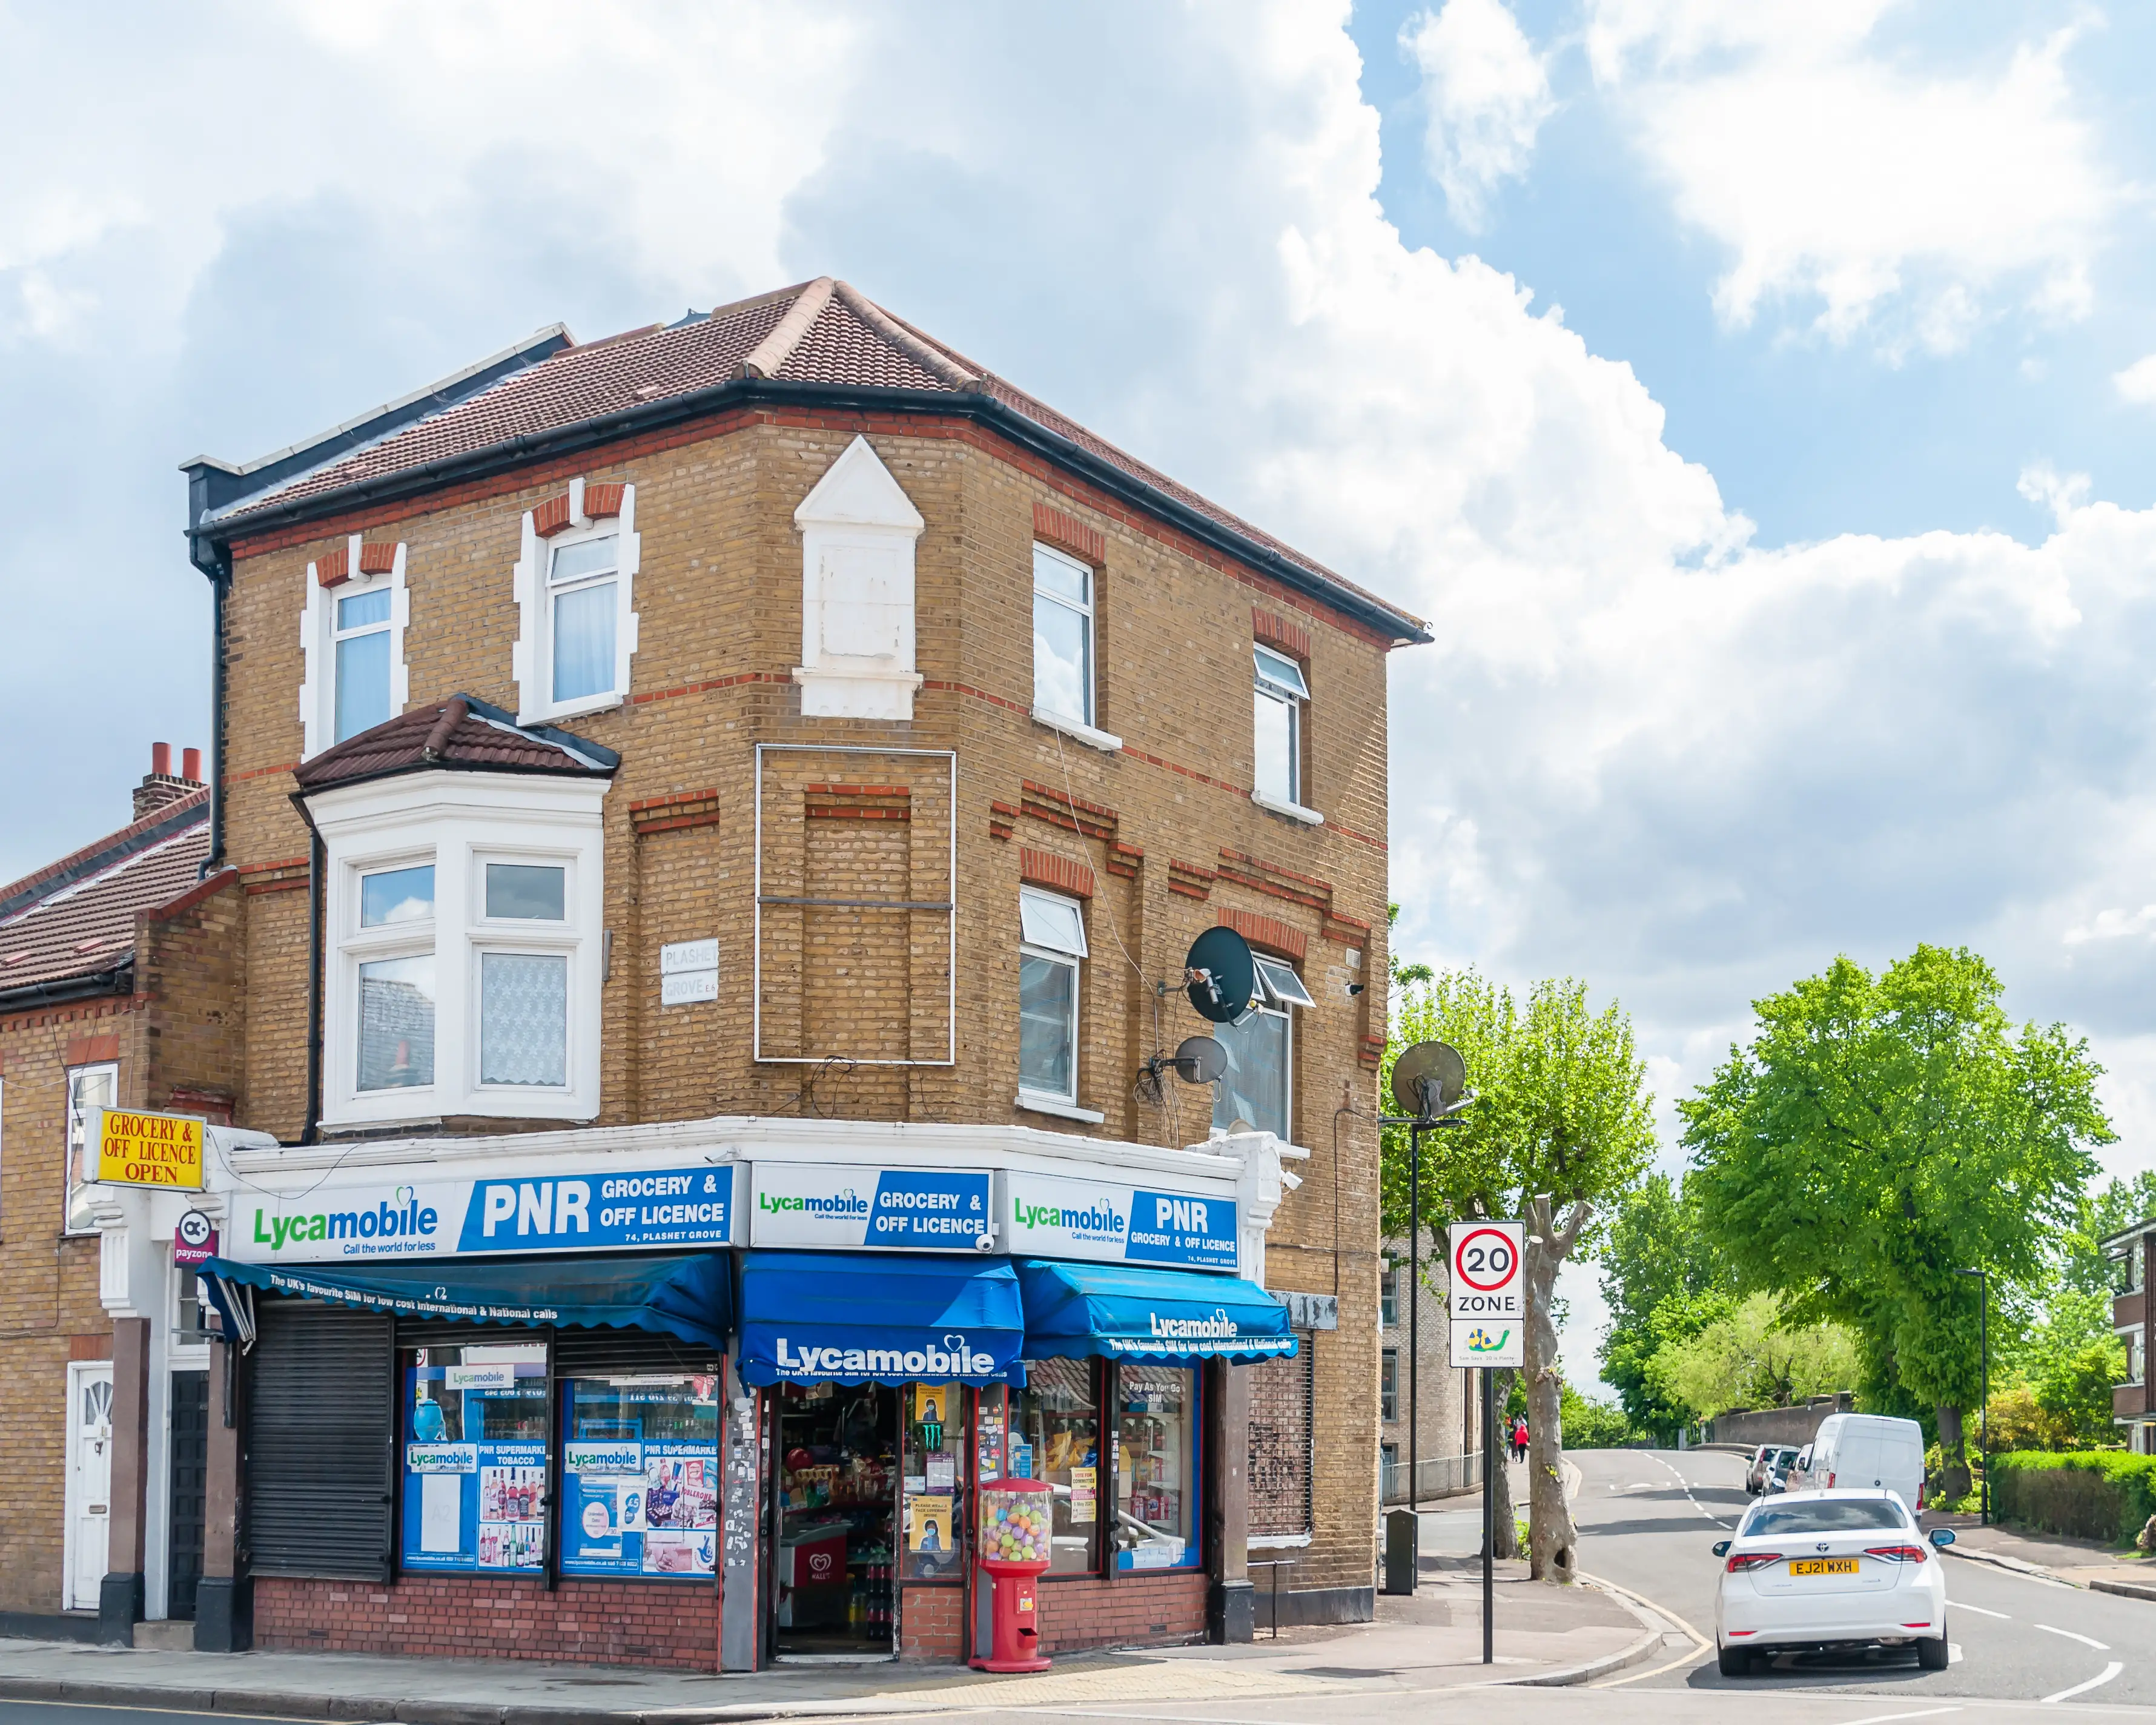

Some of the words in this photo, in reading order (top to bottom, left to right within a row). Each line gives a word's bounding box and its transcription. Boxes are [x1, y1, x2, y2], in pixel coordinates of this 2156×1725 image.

[666, 946, 718, 965] PLASHET
[666, 979, 703, 997] GROVE
[110, 1114, 177, 1141] GROCERY
[182, 1122, 193, 1142] &
[104, 1137, 130, 1158] OFF
[139, 1141, 196, 1164] LICENCE
[125, 1163, 177, 1183] OPEN
[601, 1176, 693, 1199] GROCERY
[703, 1174, 717, 1194] &
[483, 1180, 591, 1237] PNR
[760, 1192, 868, 1213] Lycamobile
[879, 1191, 960, 1210] GROCERY
[970, 1194, 982, 1210] &
[600, 1207, 637, 1227] OFF
[641, 1203, 724, 1225] LICENCE
[1014, 1197, 1125, 1233] Lycamobile
[1156, 1197, 1209, 1234] PNR
[254, 1199, 438, 1250] Lycamobile
[876, 1216, 908, 1233] OFF
[913, 1217, 985, 1234] LICENCE
[626, 1234, 640, 1243] 74,
[643, 1231, 686, 1240] PLASHET
[688, 1230, 722, 1239] GROVE
[1131, 1231, 1170, 1247] GROCERY
[1174, 1237, 1181, 1248] &
[1185, 1237, 1200, 1249] OFF
[1202, 1238, 1235, 1253] LICENCE
[176, 1249, 213, 1260] payzone
[343, 1243, 360, 1254] Call
[362, 1243, 375, 1253] the
[377, 1242, 402, 1252] world
[404, 1242, 417, 1251] for
[418, 1241, 435, 1251] less
[1196, 1256, 1219, 1264] PLASHET
[1467, 1248, 1509, 1272] 20
[271, 1274, 285, 1286] The
[286, 1278, 305, 1291] UK's
[306, 1282, 343, 1299] favourite
[345, 1290, 362, 1302] SIM
[363, 1293, 375, 1304] for
[377, 1295, 393, 1306] low
[395, 1299, 415, 1309] cost
[417, 1300, 477, 1316] International
[480, 1306, 487, 1316] &
[489, 1306, 531, 1319] National
[533, 1309, 558, 1319] calls
[1459, 1296, 1515, 1311] ZONE
[1149, 1312, 1238, 1338] Lycamobile
[776, 1337, 995, 1372] Lycamobile
[454, 1371, 504, 1384] Lycamobile
[1129, 1381, 1143, 1392] Pay
[1144, 1382, 1154, 1391] As
[1156, 1383, 1169, 1392] You
[1171, 1384, 1181, 1392] Go
[1148, 1393, 1162, 1403] SIM
[411, 1451, 473, 1466] Lycamobile
[479, 1445, 494, 1455] PNR
[569, 1451, 636, 1466] Lycamobile
[644, 1445, 661, 1455] PNR
[497, 1456, 535, 1465] TOBACCO
[628, 1498, 639, 1508] £5
[1796, 1562, 1824, 1574] EJ21
[1828, 1560, 1852, 1573] WXH
